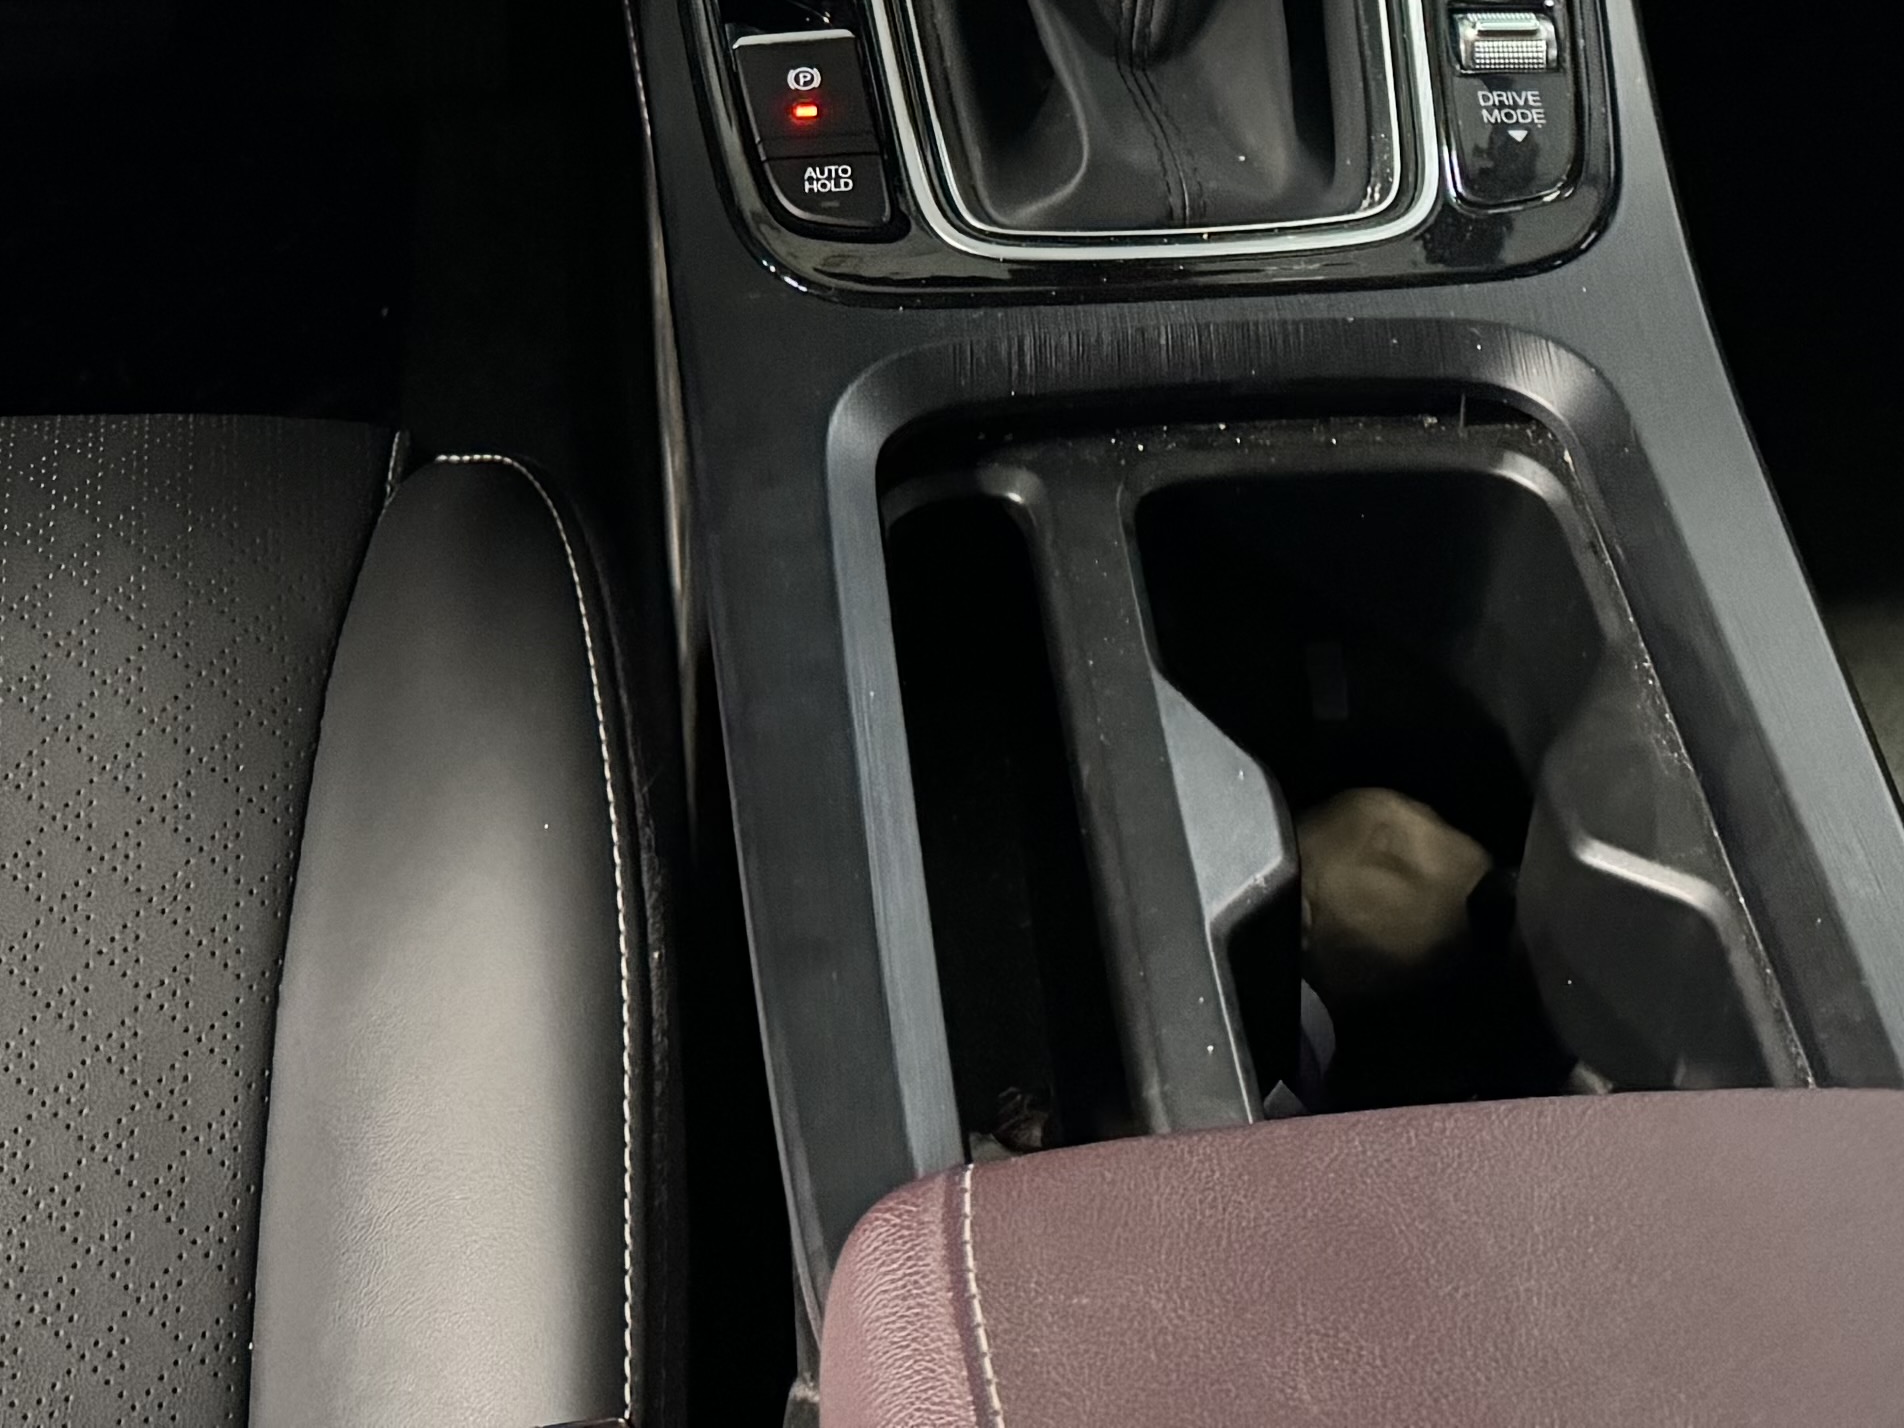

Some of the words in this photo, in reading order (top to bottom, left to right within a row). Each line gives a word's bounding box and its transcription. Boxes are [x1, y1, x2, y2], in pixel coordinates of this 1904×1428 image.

[1477, 90, 1543, 106] DRIVE
[1481, 108, 1547, 124] MODE
[804, 164, 852, 180] AUTO
[804, 178, 854, 194] HOLD
